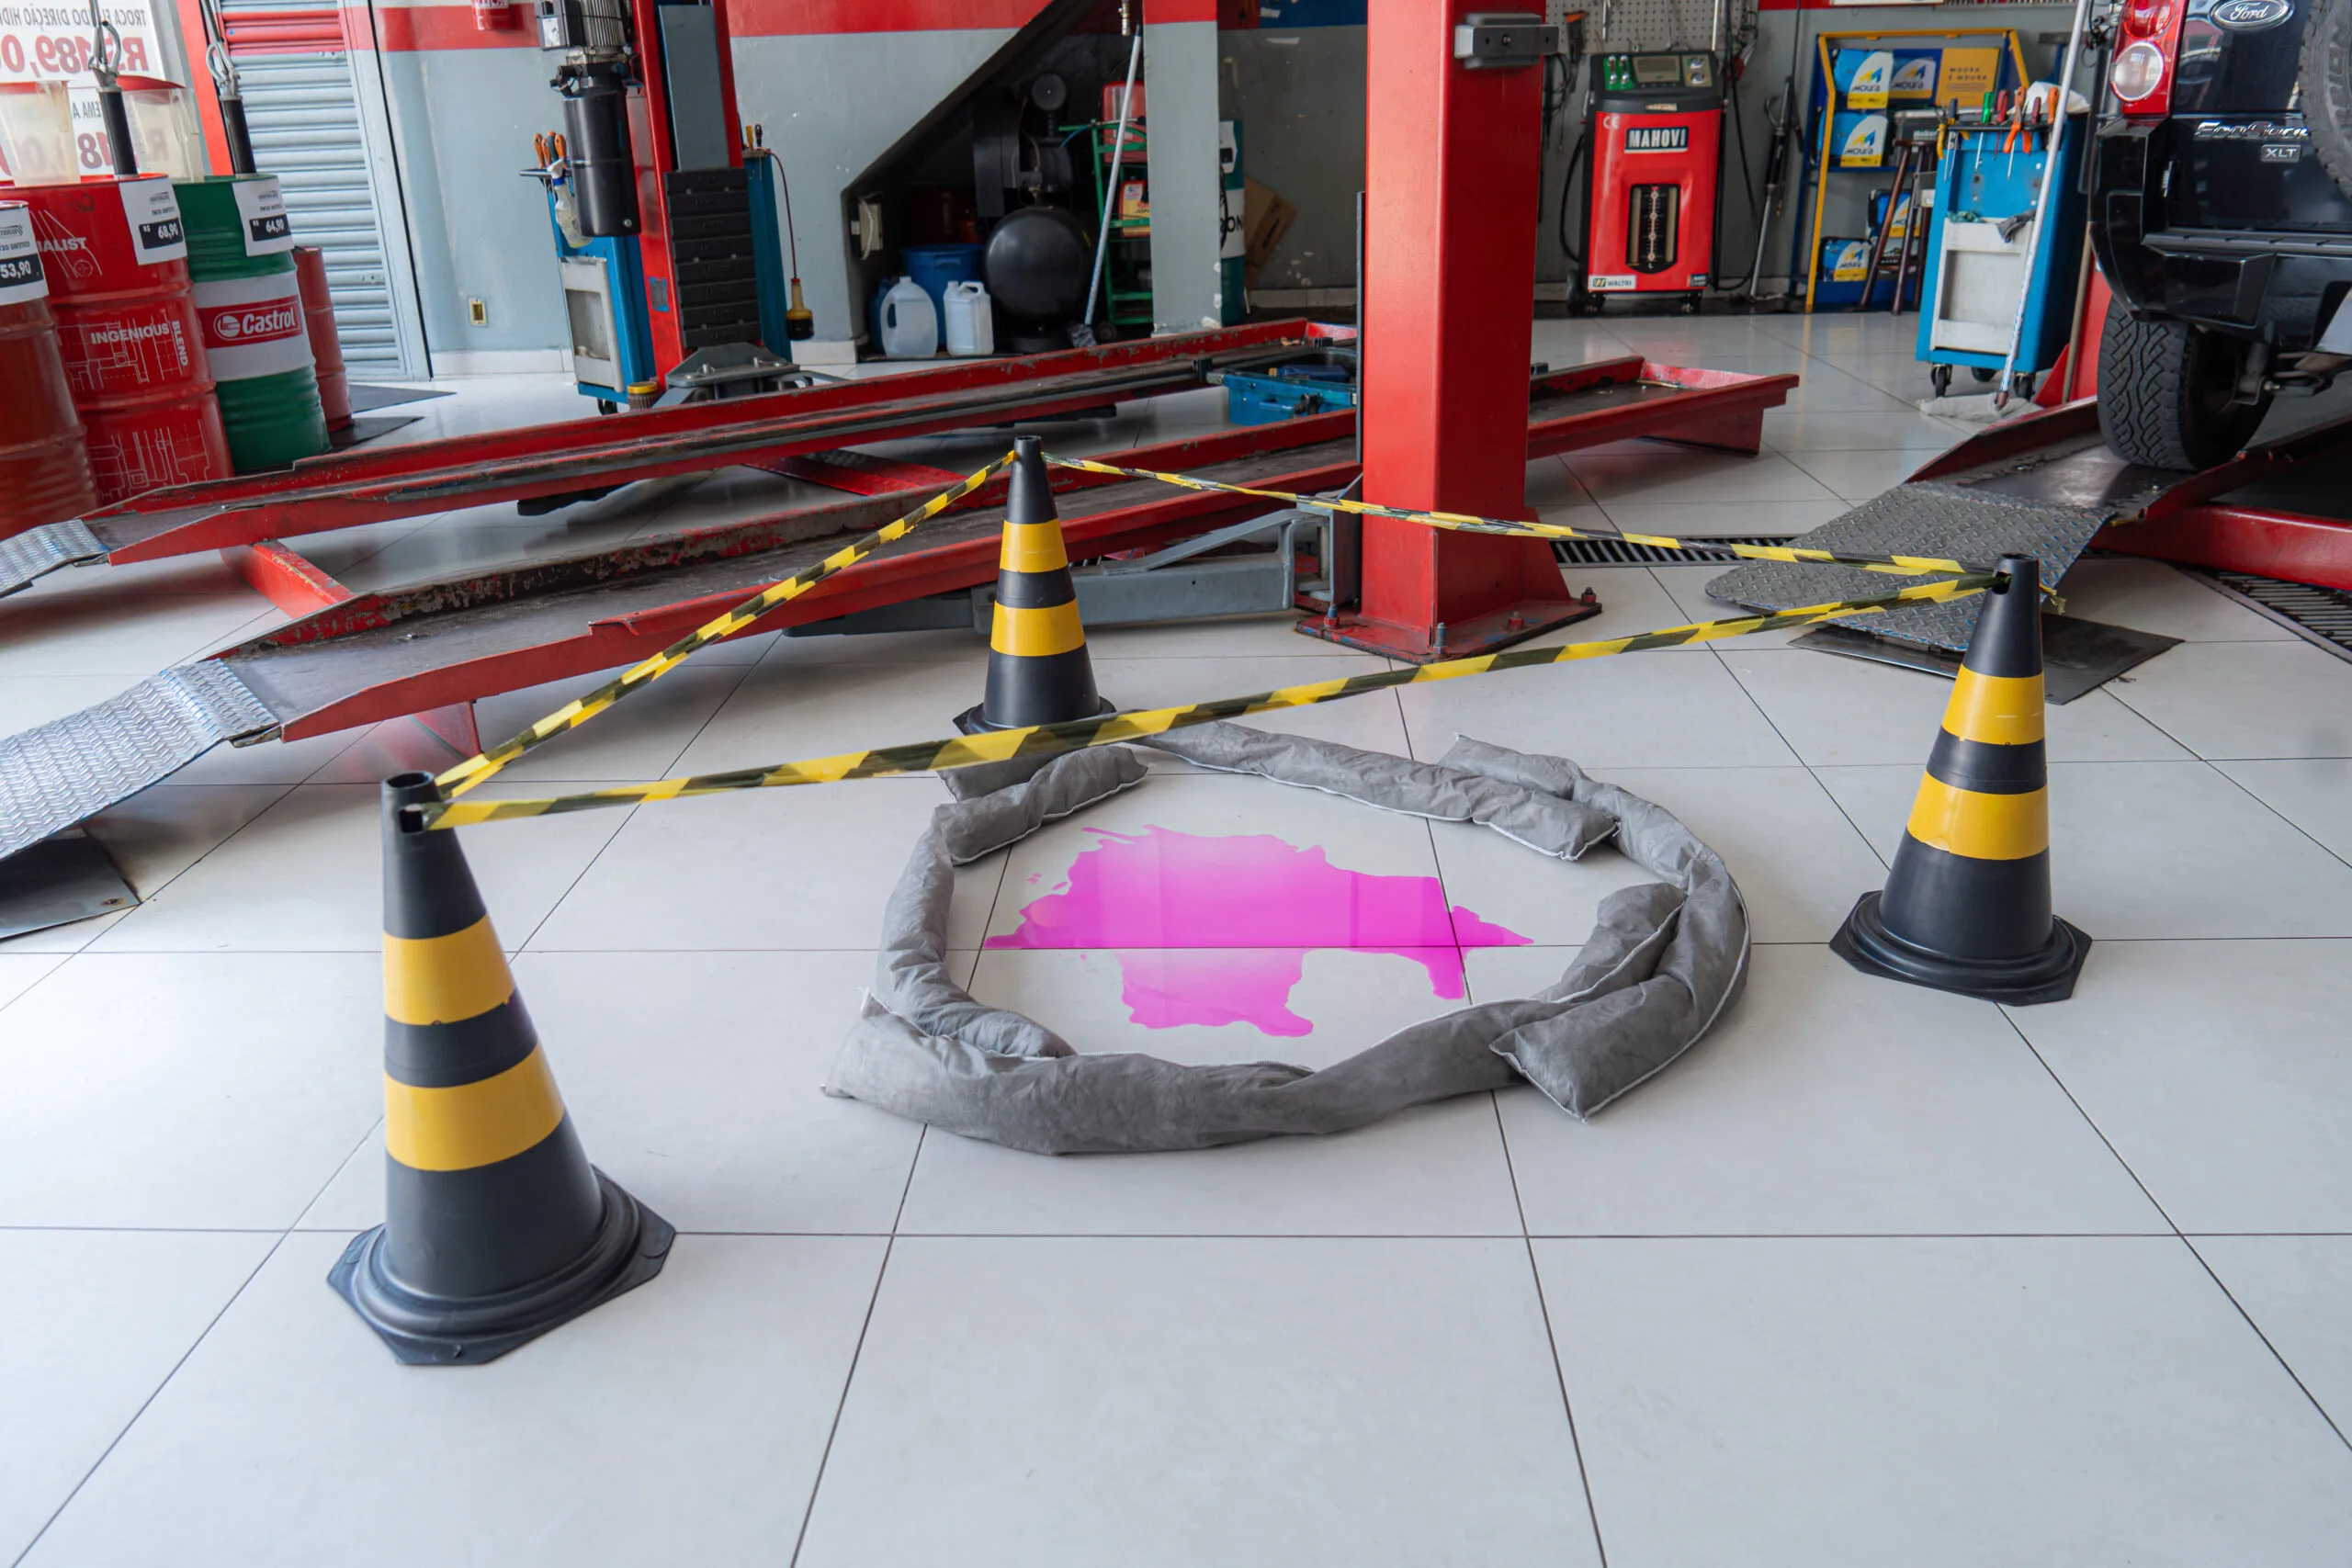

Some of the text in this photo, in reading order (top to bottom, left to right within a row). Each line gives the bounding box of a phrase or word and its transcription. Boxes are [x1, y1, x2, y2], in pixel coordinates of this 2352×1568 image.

[2230, 2, 2270, 20] Ford
[1628, 129, 1686, 147] MAHOVI
[2267, 148, 2297, 158] XLT
[266, 219, 285, 233] 64,90
[37, 237, 86, 253] IALIST
[0, 260, 31, 279] 53,90
[243, 306, 296, 334] Castrol
[90, 323, 170, 344] INGENIOUS
[172, 320, 188, 367] BLEND
